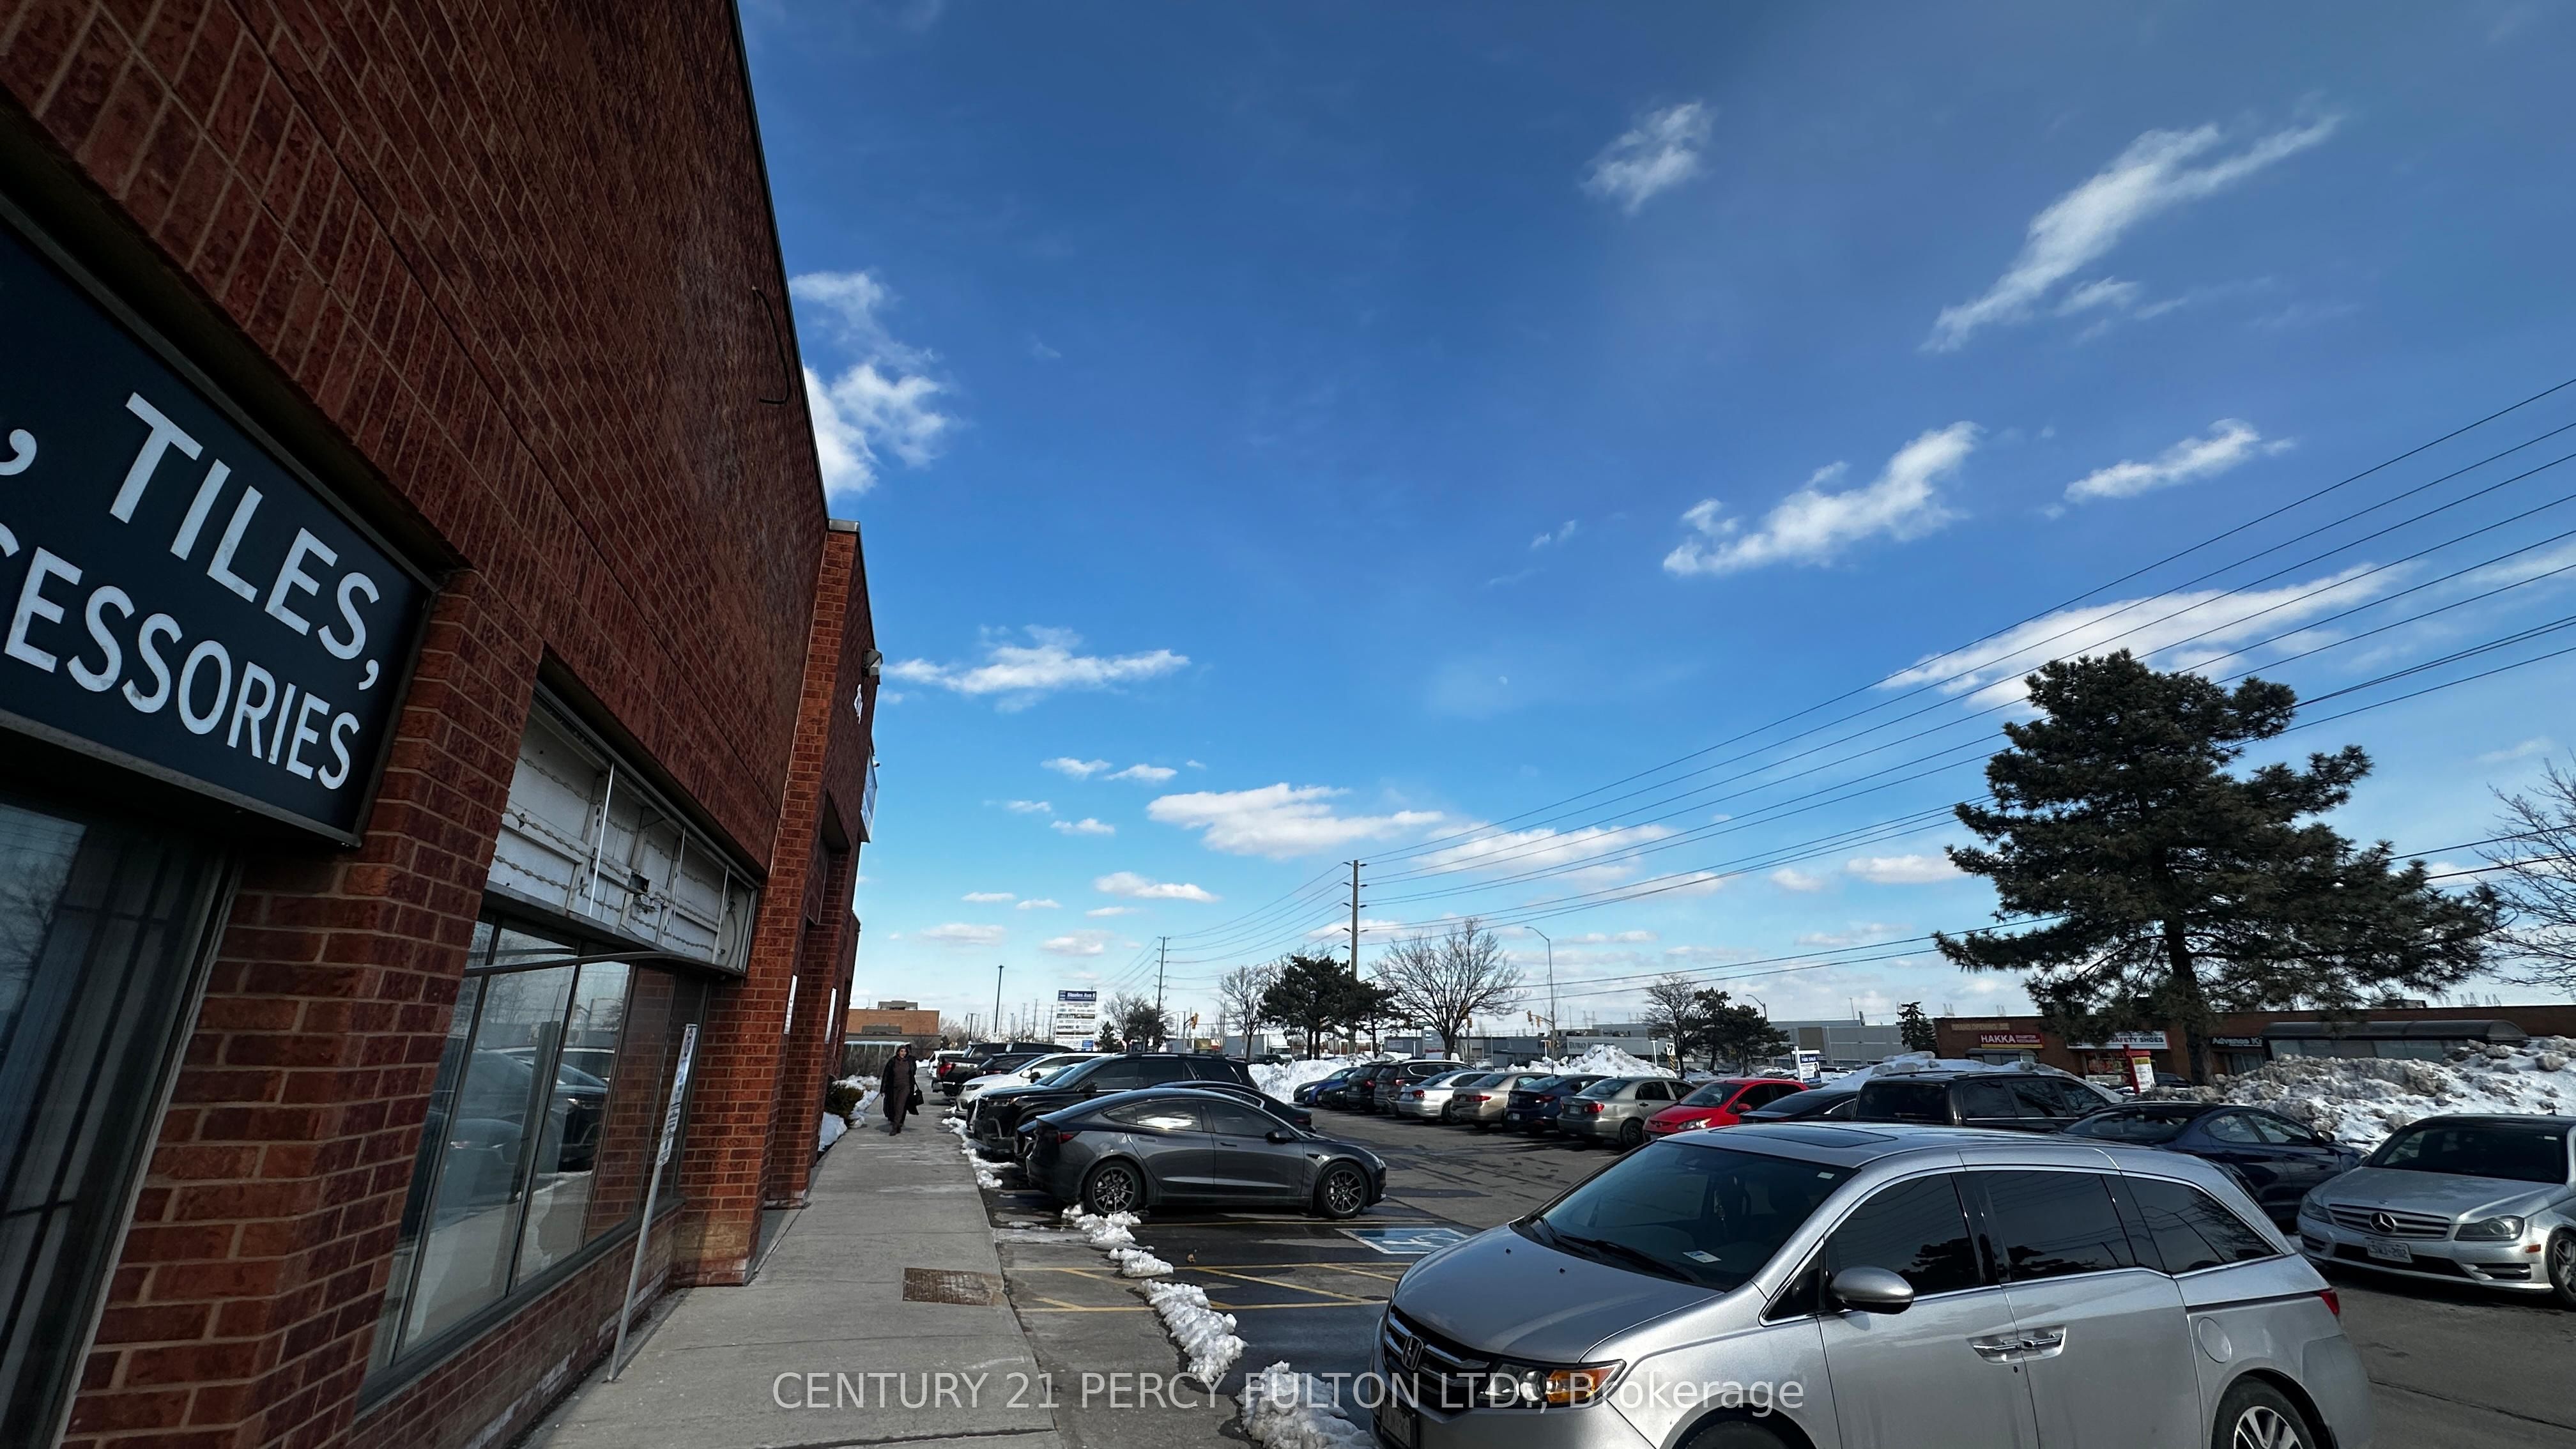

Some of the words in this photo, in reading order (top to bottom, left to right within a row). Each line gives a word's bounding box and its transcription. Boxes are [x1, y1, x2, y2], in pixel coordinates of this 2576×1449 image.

[0, 523, 362, 790] ESSORIES
[110, 392, 381, 691] TILES,
[1981, 1034, 2016, 1043] HAKKA
